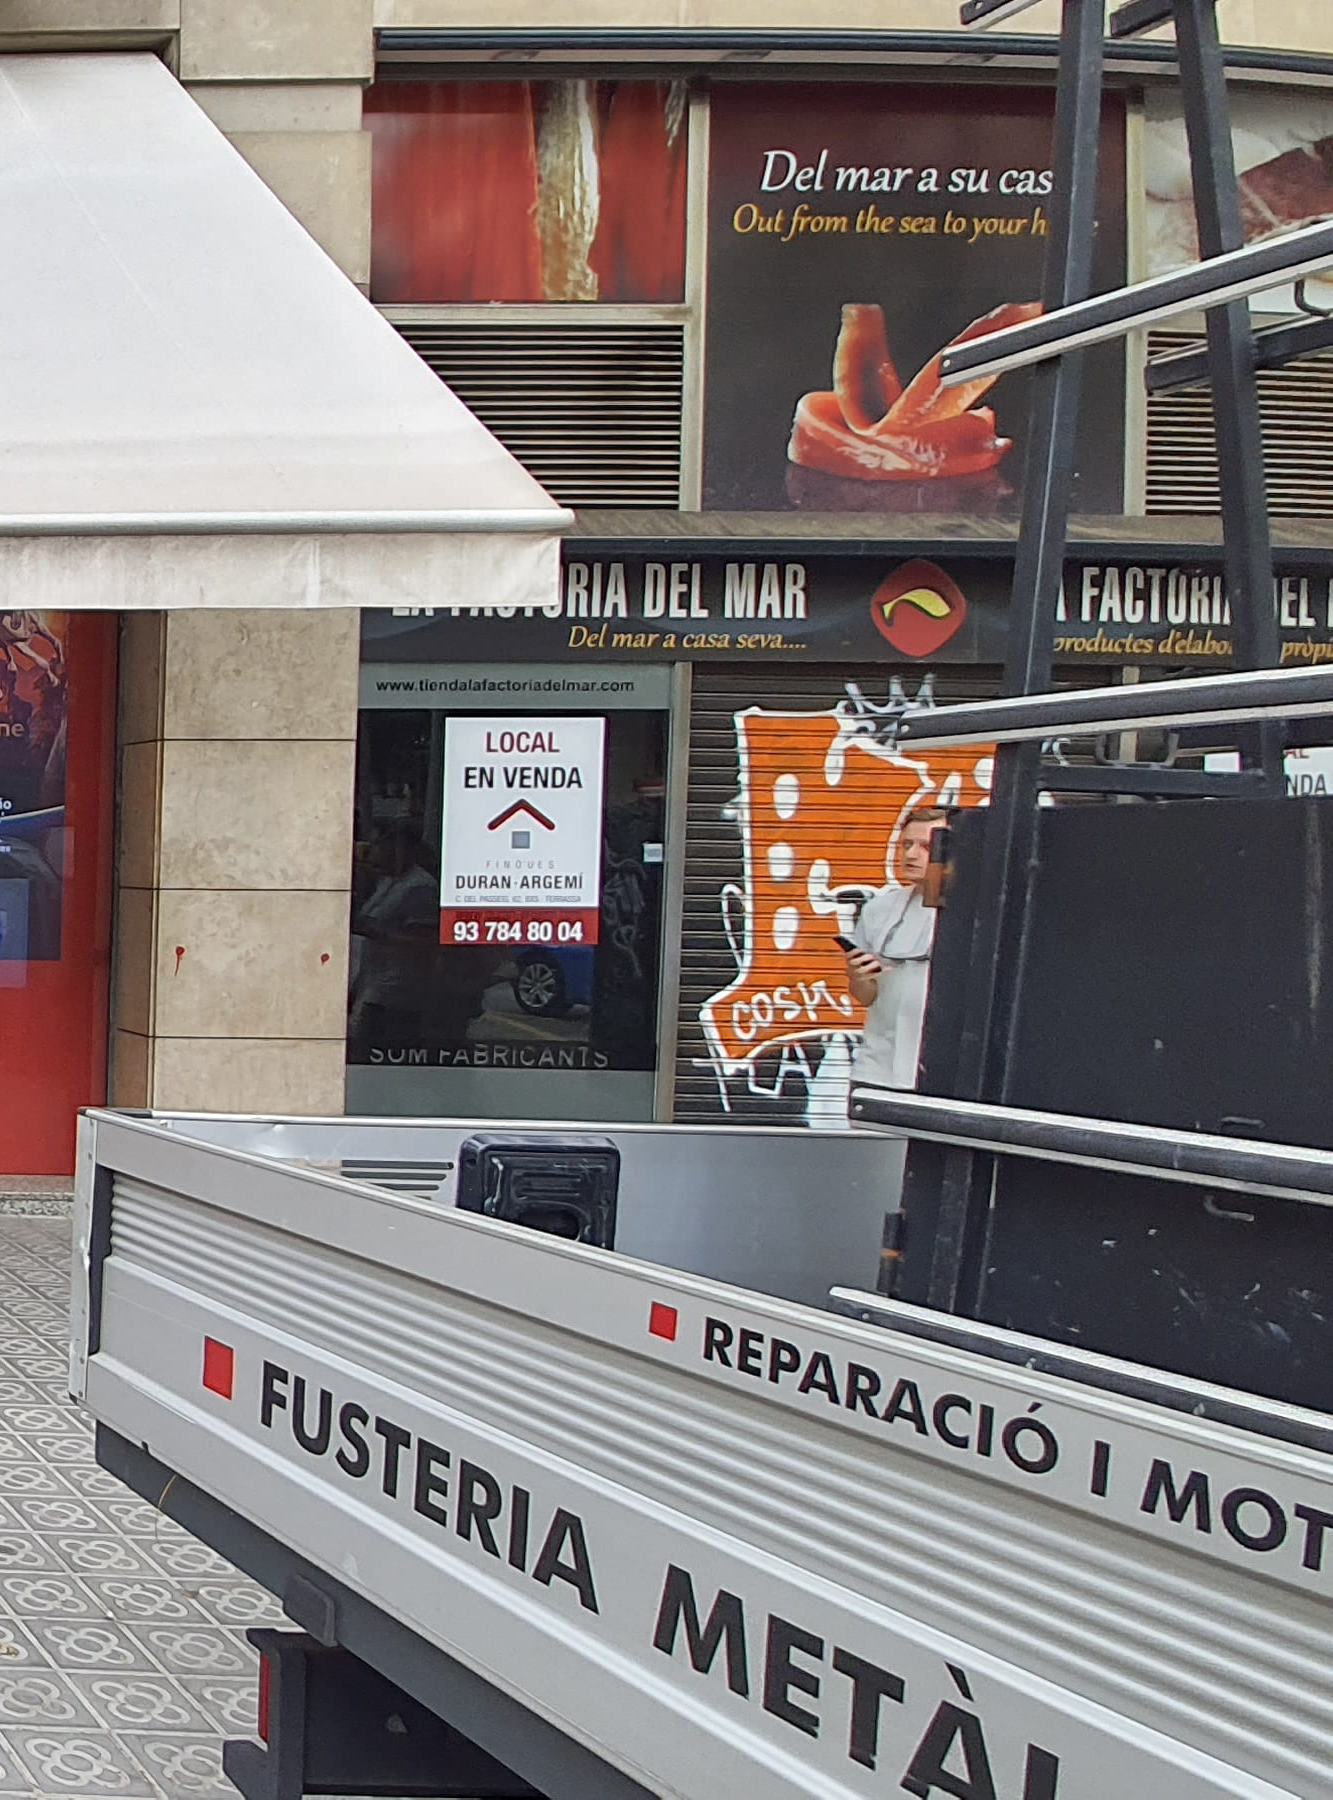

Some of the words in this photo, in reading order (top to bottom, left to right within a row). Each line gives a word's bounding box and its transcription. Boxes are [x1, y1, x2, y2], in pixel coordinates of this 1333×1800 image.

[761, 149, 828, 192] Del
[835, 167, 912, 192] mar
[917, 168, 938, 192] a
[947, 165, 989, 193] su
[998, 168, 1053, 194] cas
[733, 203, 784, 233] Out
[781, 204, 848, 242] from
[855, 205, 894, 233] the
[899, 217, 935, 233] sea
[943, 213, 967, 233] to
[968, 220, 1027, 243] your
[644, 563, 710, 618] DEL
[724, 564, 807, 619] MAR
[1273, 577, 1316, 627] EL
[568, 623, 607, 648] Del
[612, 630, 659, 648] mar
[662, 632, 676, 648] a
[682, 633, 729, 648] casa
[376, 678, 635, 692] www.tiendalafactoriadelmar.com
[486, 731, 560, 753] LOCAL
[464, 766, 494, 788] EN
[503, 766, 583, 789] VENDA
[1285, 774, 1327, 795] NDA
[453, 921, 479, 941] 93
[484, 921, 522, 941] 784
[527, 921, 553, 941] 80
[558, 921, 583, 941] 04
[369, 1048, 427, 1063] SOM
[439, 1044, 609, 1068] FABRICANTS
[703, 1316, 1059, 1474] REPARACIÓ
[1091, 1440, 1110, 1497] I
[1139, 1459, 1333, 1571] MOT
[260, 1360, 599, 1615] FUSTERIA
